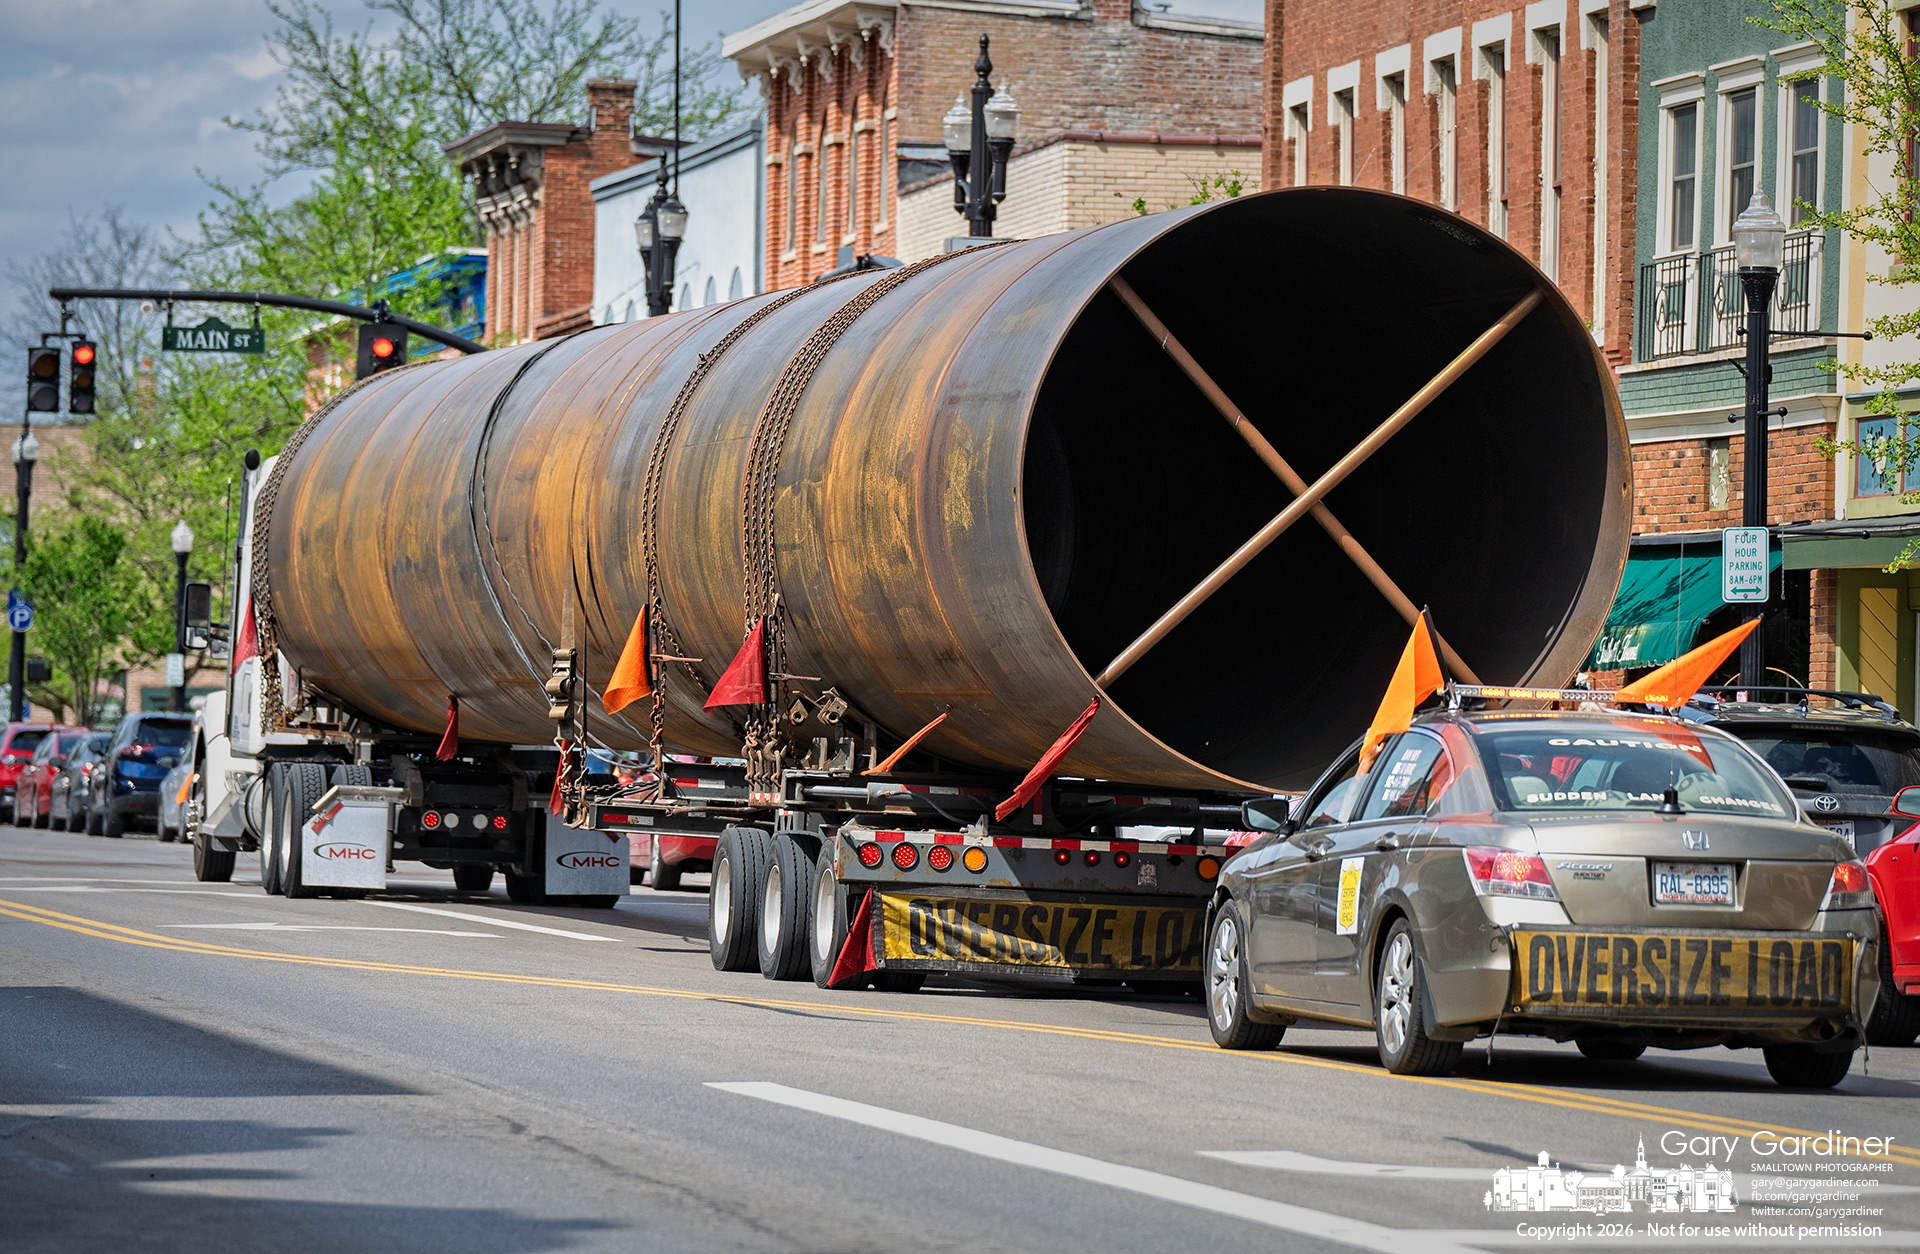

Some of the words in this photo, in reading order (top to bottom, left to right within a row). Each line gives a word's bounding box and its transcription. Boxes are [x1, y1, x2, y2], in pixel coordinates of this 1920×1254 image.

[176, 329, 230, 350] MAIN
[233, 333, 251, 348] ST
[1734, 534, 1758, 544] FOUR
[1734, 547, 1758, 558] HOUR
[1728, 561, 1763, 571] PARKING
[1728, 575, 1763, 585] 8AM-6PM
[1548, 738, 1702, 753] CAUTION
[1526, 791, 1607, 803] SUDDEN
[1626, 792, 1665, 802] LAN
[1699, 795, 1784, 813] CHANGES
[328, 847, 377, 860] MHC
[571, 855, 621, 868] MHC
[1555, 861, 1613, 871] Accord
[1660, 873, 1729, 895] RAL-8395
[909, 898, 1119, 966] OVERSIZE
[1130, 908, 1205, 970] LOA
[1528, 933, 1732, 1007] OVERSIZE
[1746, 940, 1843, 1008] LOAD
